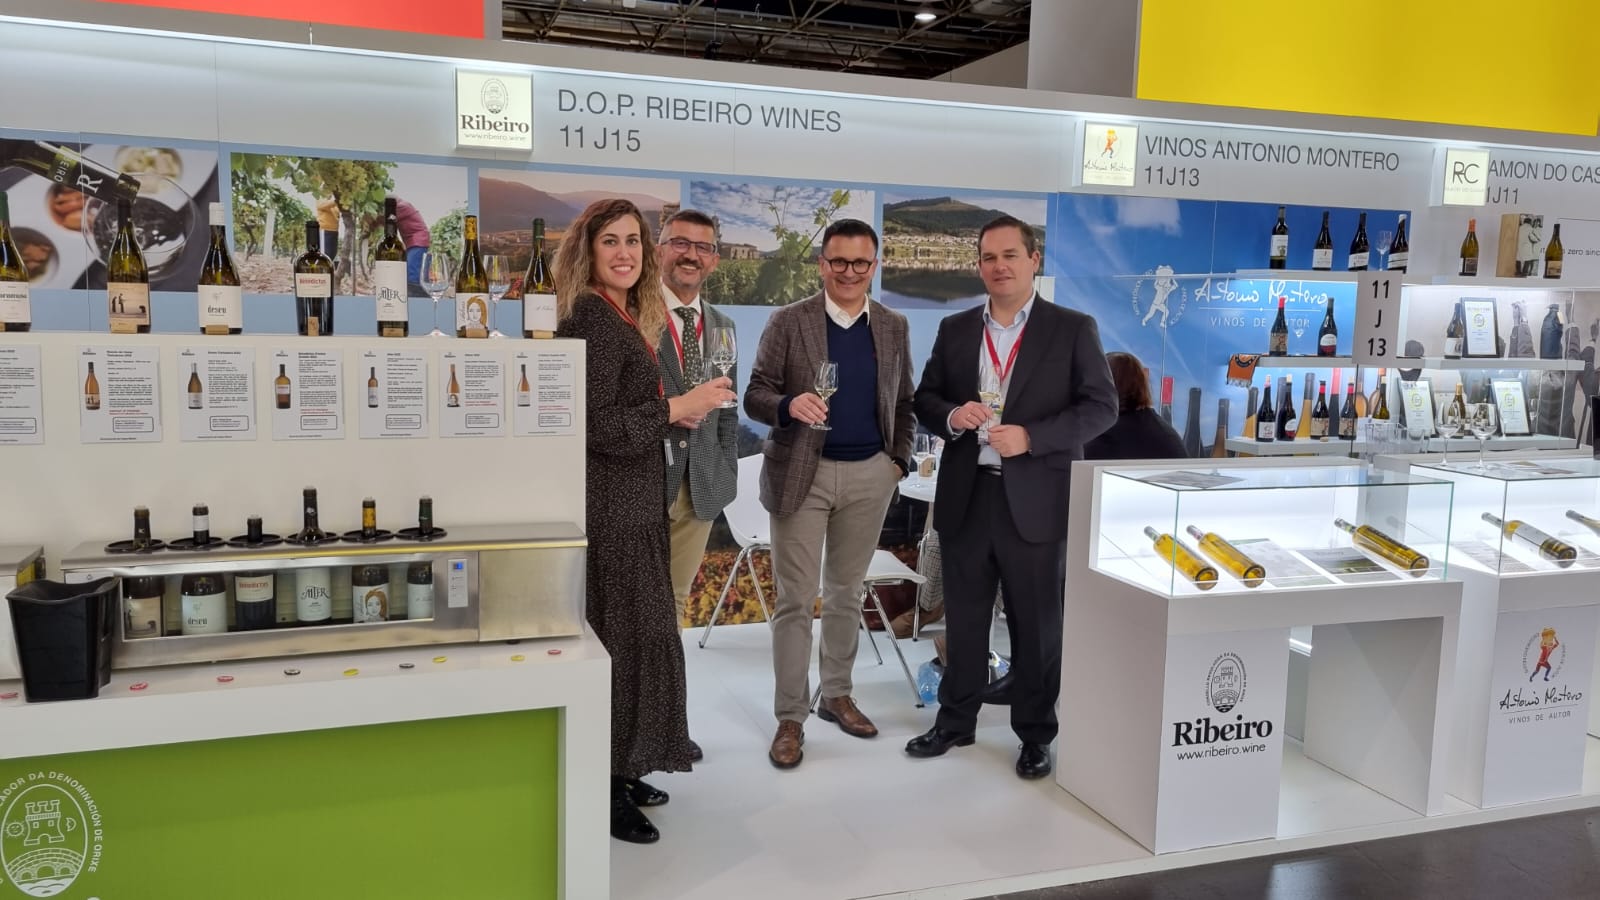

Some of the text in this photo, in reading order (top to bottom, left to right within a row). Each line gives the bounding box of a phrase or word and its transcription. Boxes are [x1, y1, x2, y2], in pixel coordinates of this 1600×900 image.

[559, 89, 842, 133] D.O.P. RIBEIRO WINES
[460, 114, 530, 133] Ribeiro
[1145, 136, 1400, 172] VINOS ANTONIO MONTERO
[1144, 165, 1200, 187] 11J13
[1452, 161, 1480, 184] RC
[1489, 159, 1538, 179] AMON
[1543, 163, 1567, 181] DO
[76, 175, 103, 194] R
[1372, 280, 1389, 299] 11
[1210, 317, 1245, 328] VINOS
[1253, 318, 1267, 328] DE
[1374, 308, 1382, 328] J
[1367, 337, 1387, 357] 13
[1508, 716, 1531, 724] VINOS
[1549, 710, 1571, 719] AUTOR
[1171, 714, 1273, 747] Ribeiro
[1177, 743, 1267, 761] www.ribeiro.wine
[28, 771, 46, 781] DA
[48, 771, 102, 827] DENOMINACIÓN
[94, 829, 103, 842] DE
[87, 844, 103, 873] ORIXE
